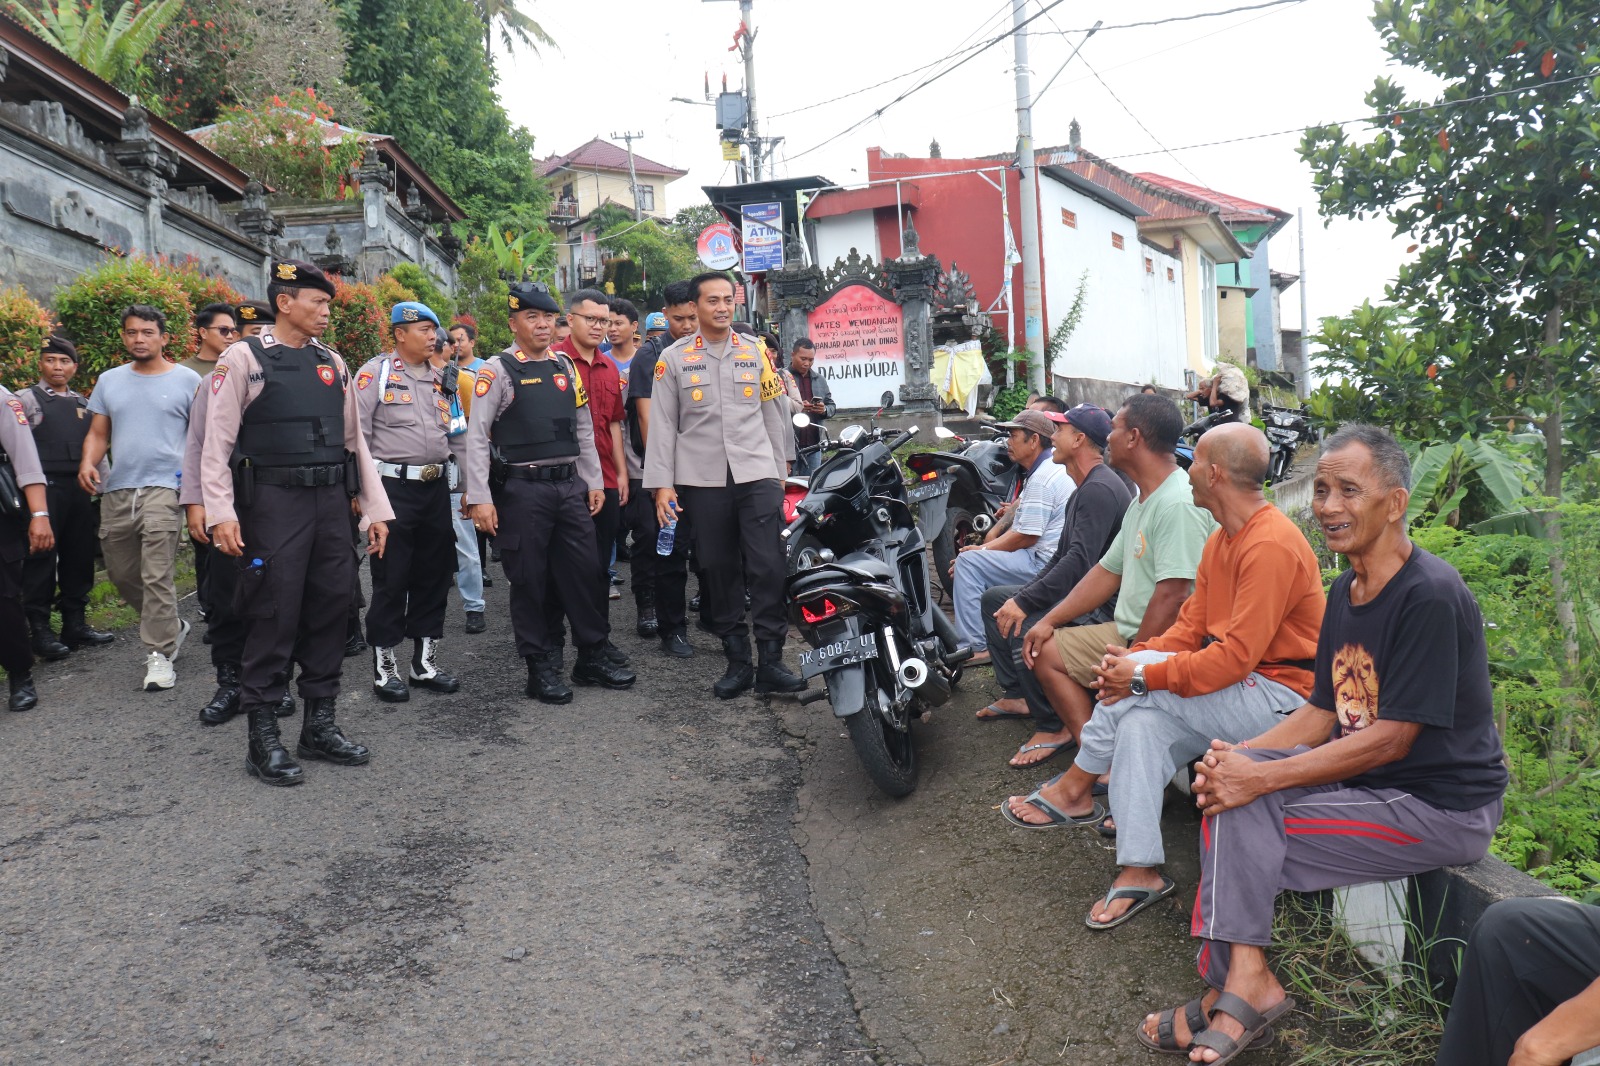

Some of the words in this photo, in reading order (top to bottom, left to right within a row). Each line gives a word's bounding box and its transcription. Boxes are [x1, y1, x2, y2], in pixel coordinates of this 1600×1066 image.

[750, 226, 777, 237] ATM
[814, 320, 841, 329] WATES
[815, 341, 841, 350] BANJAR
[842, 339, 859, 348] ADAT
[862, 338, 876, 346] LAN
[879, 336, 899, 345] DINAS
[682, 363, 707, 372] WIDWAN
[734, 361, 757, 369] POLRI
[818, 363, 862, 380] DAJAN
[864, 361, 899, 378] PURA
[819, 640, 851, 660] 6082
